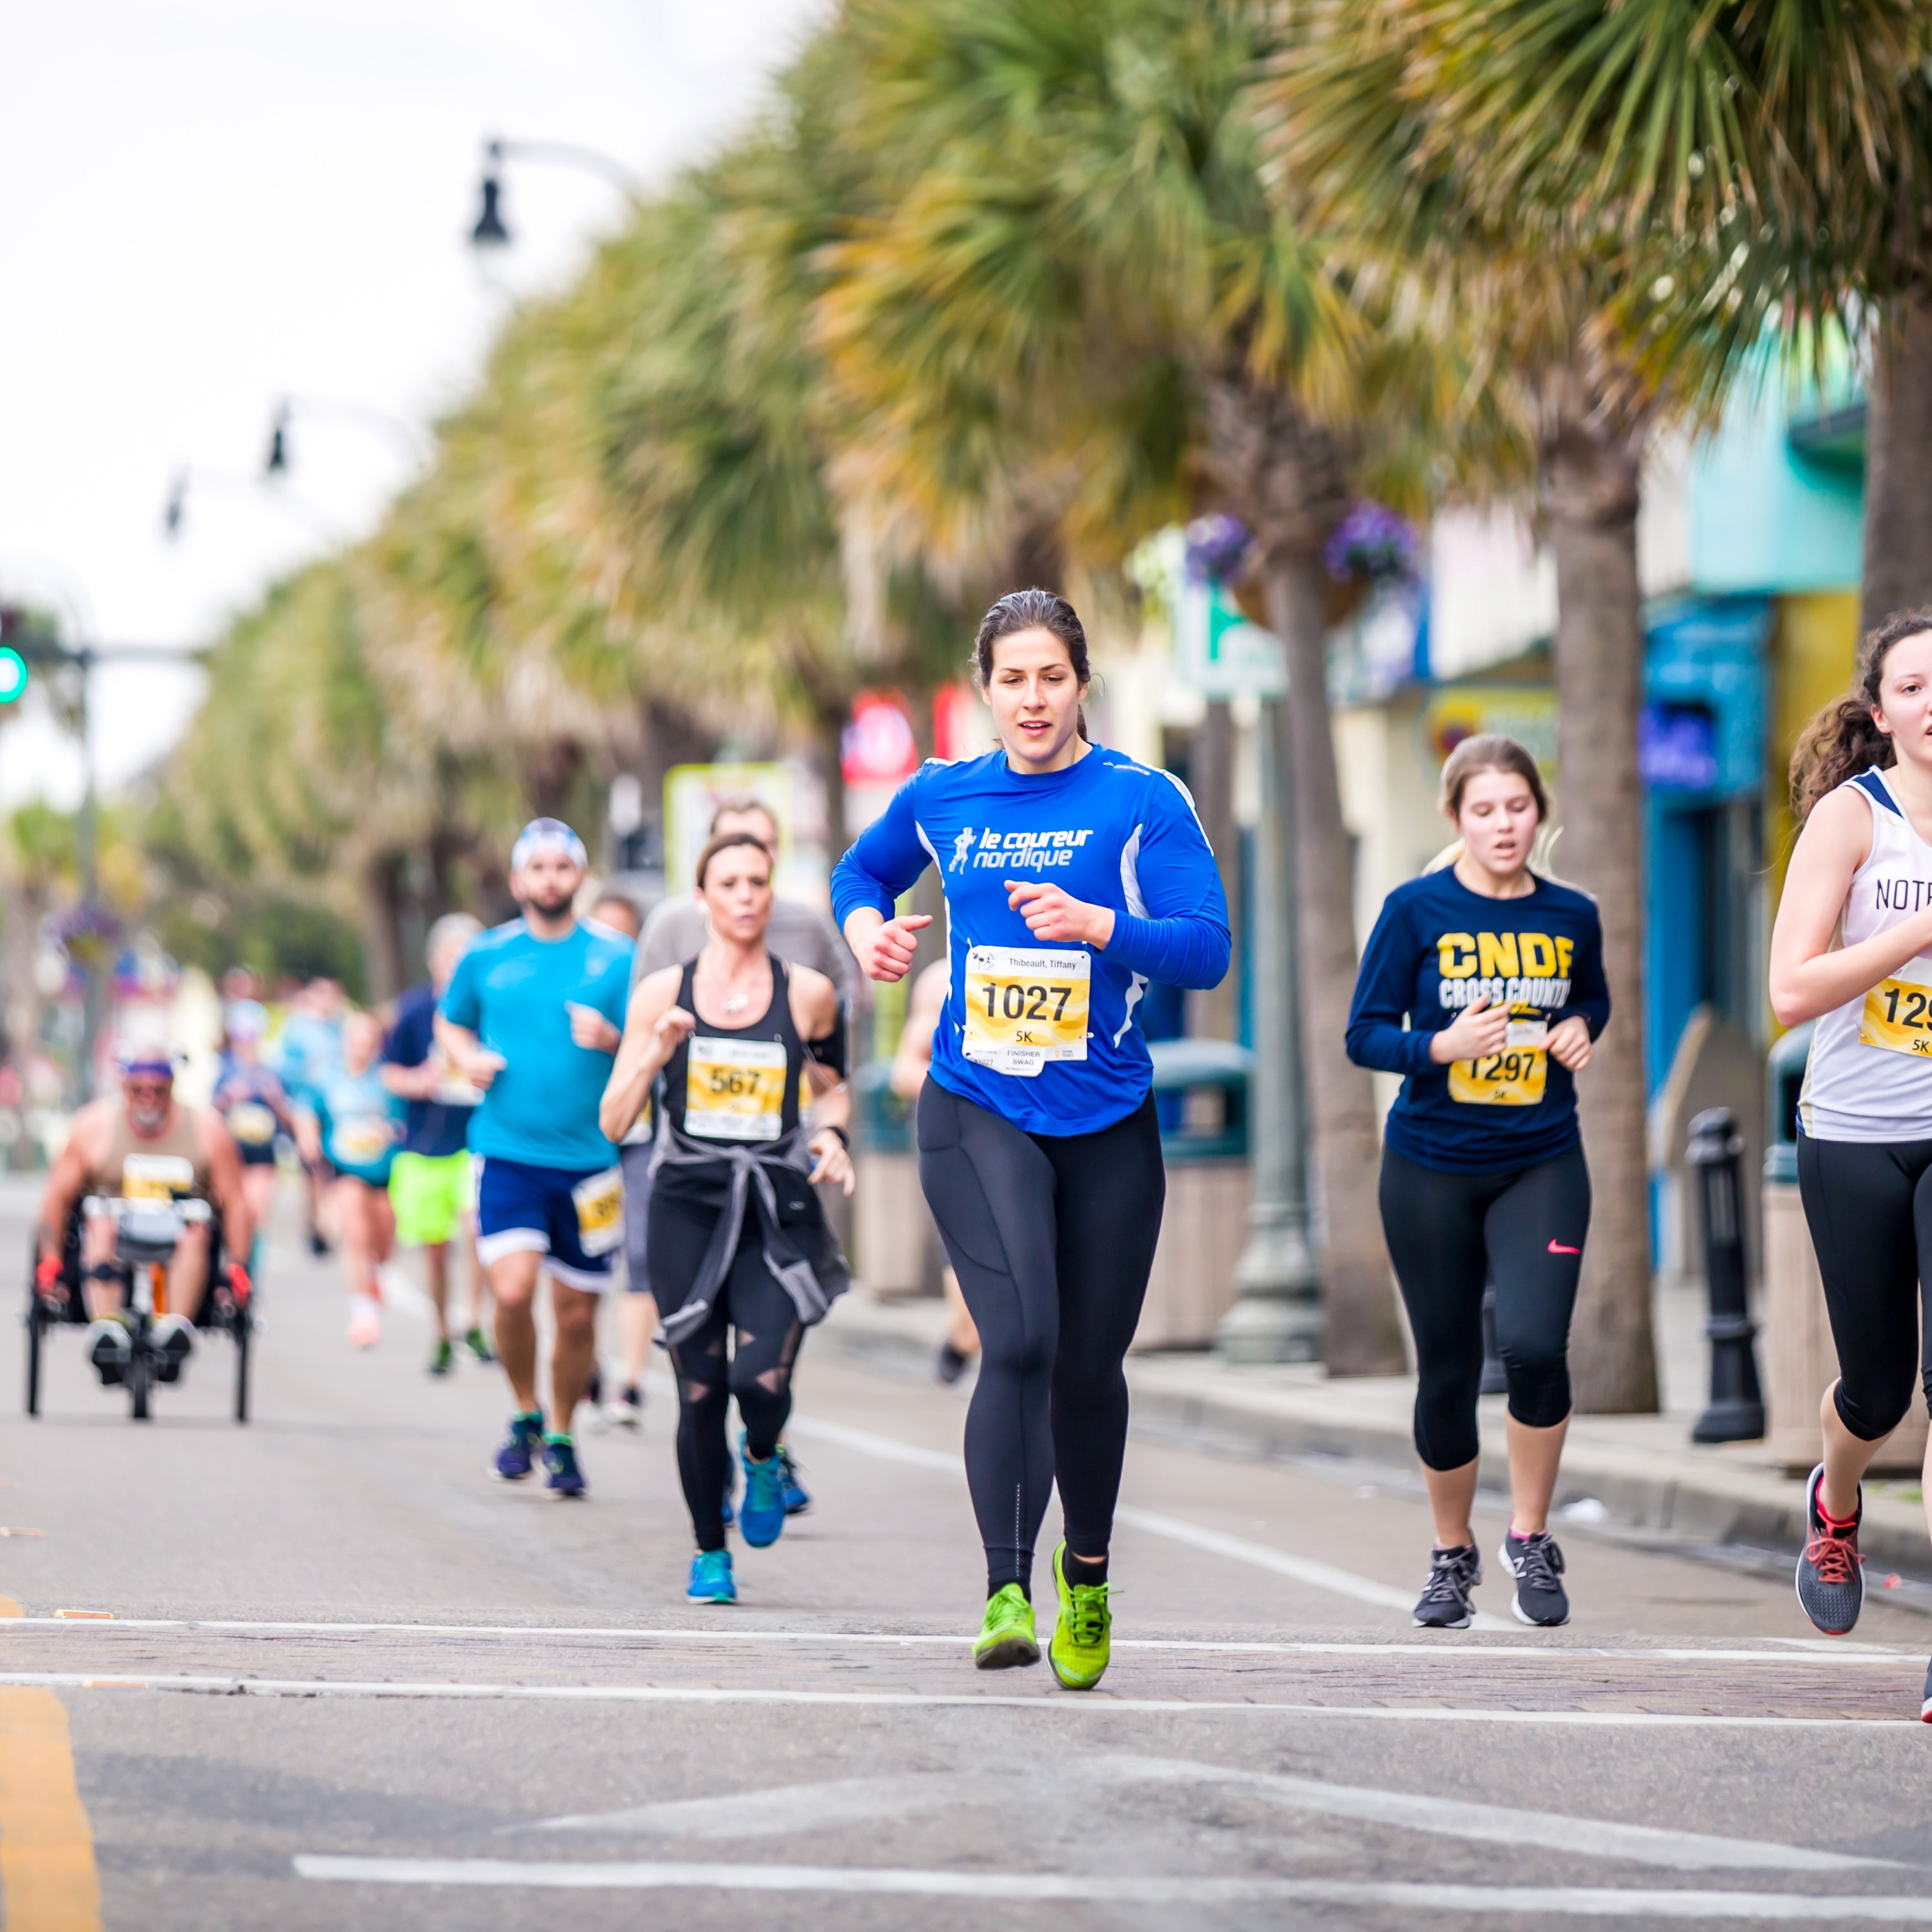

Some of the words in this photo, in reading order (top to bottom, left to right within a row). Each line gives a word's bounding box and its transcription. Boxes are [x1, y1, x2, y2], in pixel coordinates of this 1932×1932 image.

[979, 827, 1001, 849] le
[1003, 830, 1093, 849] coureur
[973, 847, 1073, 873] nordique
[1009, 958, 1047, 969] Thibeault,
[1050, 959, 1077, 970] Tiffany
[983, 982, 1072, 1021] 1027
[1438, 977, 1505, 1009] CROSS
[1884, 988, 1932, 1031] 129
[1015, 1031, 1033, 1043] 5K
[1912, 1039, 1930, 1053] 5K
[1471, 1053, 1535, 1082] 1297
[711, 1068, 761, 1096] 567
